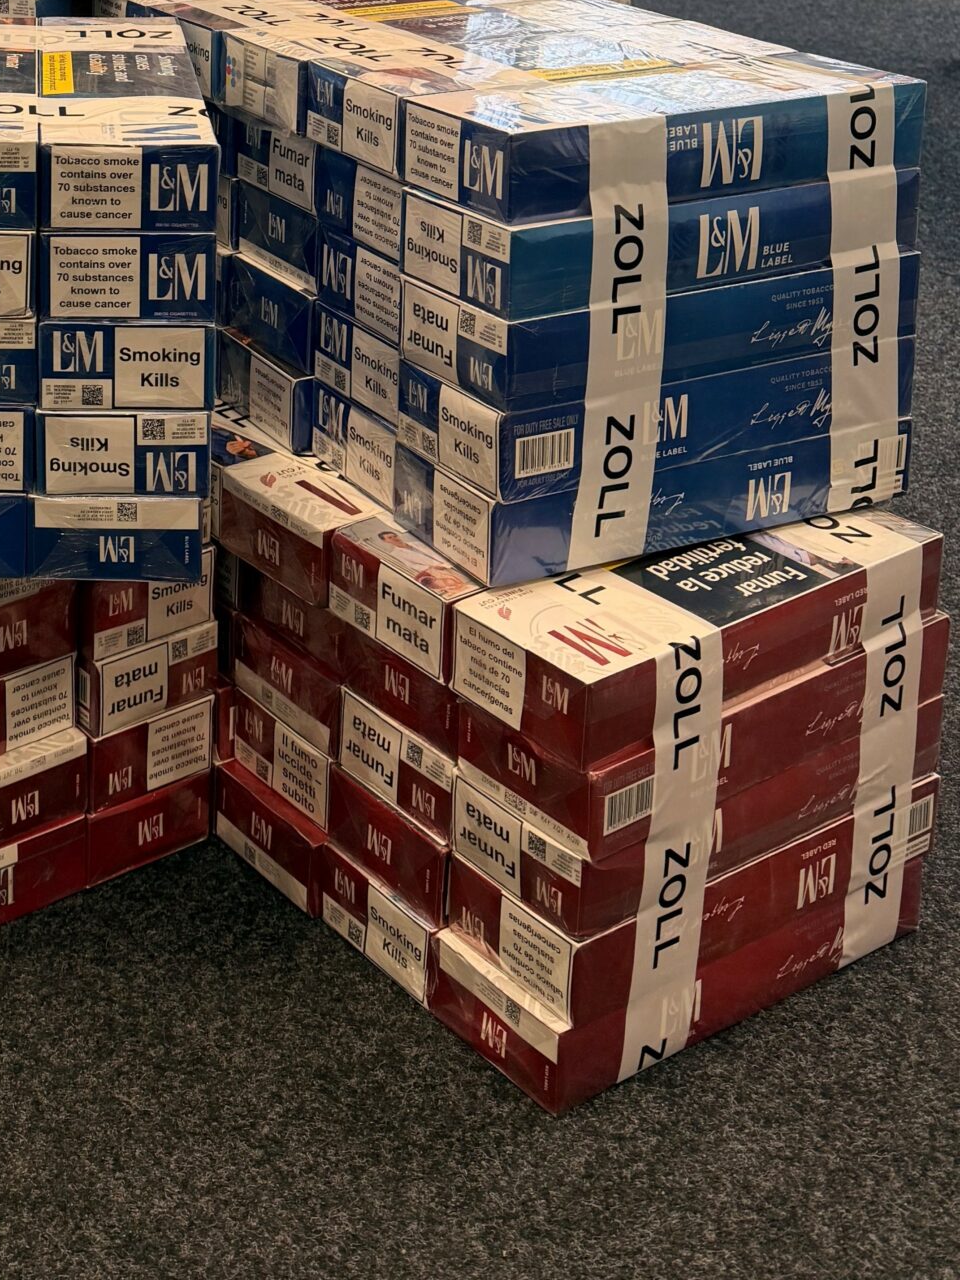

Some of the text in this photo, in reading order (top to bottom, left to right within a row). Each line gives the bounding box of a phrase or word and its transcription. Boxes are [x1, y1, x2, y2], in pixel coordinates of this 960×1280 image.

[315, 36, 392, 63] ZOLL
[345, 98, 393, 131] Smoking
[356, 129, 380, 148] Kills
[670, 125, 697, 137] LABE
[670, 138, 697, 151] BLUE
[55, 156, 139, 167] Tobacco smoke
[272, 139, 310, 168] Fumar
[58, 183, 135, 193] 70 substances
[60, 170, 133, 180] contains over
[149, 163, 208, 212] L&M
[275, 168, 304, 192] mata
[60, 210, 132, 219] cause cancer
[72, 196, 121, 206] known to
[696, 206, 760, 279] L&M
[763, 242, 790, 255] BLUE
[612, 203, 644, 334] ZOLL
[761, 255, 793, 268] LABEL
[771, 291, 801, 302] QUALITY
[786, 301, 806, 310] SINCE
[853, 244, 881, 367] ZOLL
[119, 347, 201, 365] Smoking
[140, 372, 180, 388] Kills
[441, 406, 493, 449] Smoking
[514, 415, 578, 436] FOR DUTY FREE SALE ONLY
[454, 439, 480, 464] Kills
[748, 455, 793, 472] BLUE LABEL
[594, 414, 636, 538] ZOLL
[646, 538, 747, 581] fertilidad
[676, 552, 772, 592] reduce la
[734, 565, 808, 597] Fumar
[381, 580, 436, 630] Fumar
[385, 617, 430, 655] mata
[880, 595, 906, 718] ZOLL
[114, 662, 159, 689] mata
[107, 684, 164, 718] Fumar
[668, 636, 703, 770] ZOLL
[465, 801, 510, 844] mata
[459, 825, 516, 879] Fumar
[801, 846, 821, 860] LABEL
[865, 785, 896, 905] ZOLL
[653, 842, 691, 969] ZOLL
[369, 905, 422, 962] Smoking
[382, 941, 409, 969] Kills
